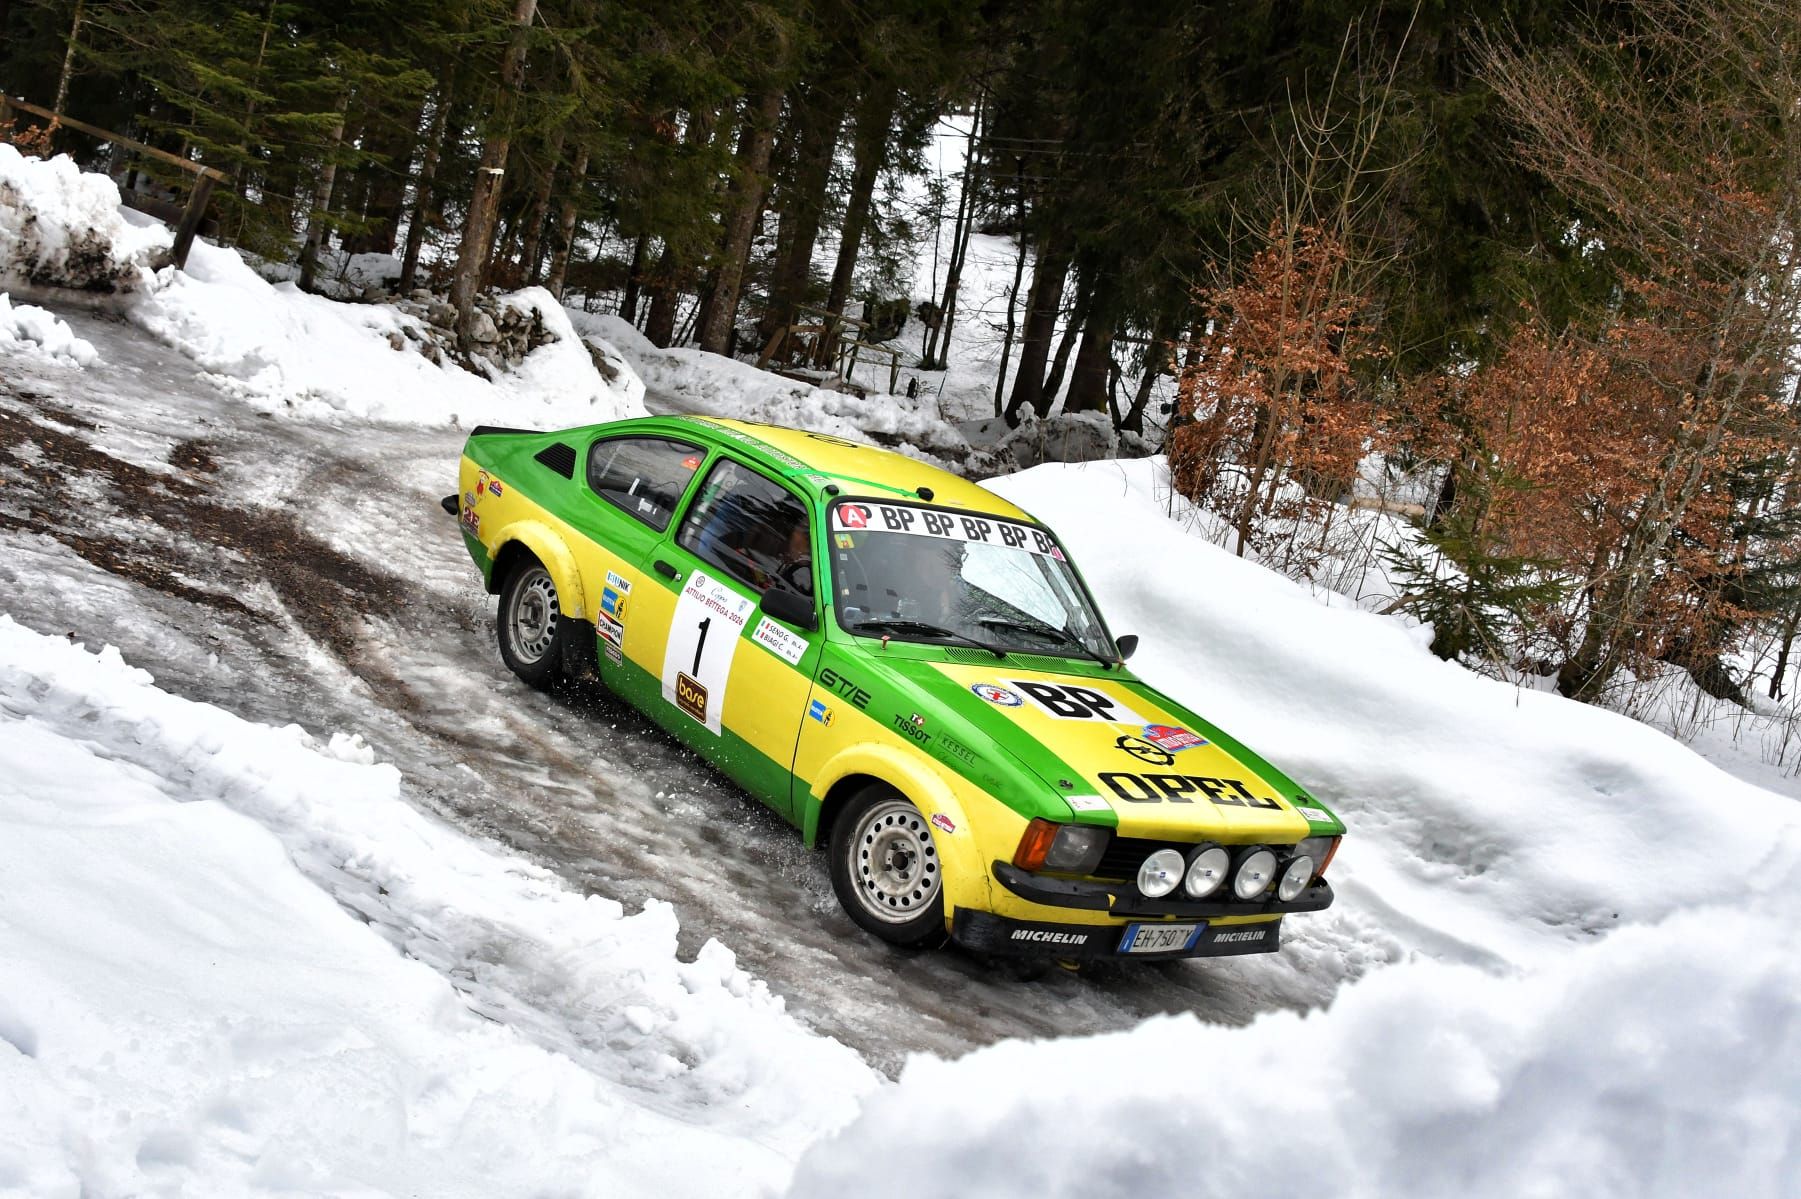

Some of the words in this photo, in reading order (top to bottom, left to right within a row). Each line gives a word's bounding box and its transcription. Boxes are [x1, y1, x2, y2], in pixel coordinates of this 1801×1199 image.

[880, 506, 914, 531] BP
[922, 512, 954, 536] BP
[960, 518, 991, 541] BP
[997, 524, 1027, 548] BP
[685, 587, 706, 602] ATTILIO
[705, 598, 729, 617] BETTEGA
[728, 612, 744, 626] 2026
[692, 617, 711, 678] 1
[763, 634, 778, 647] BIAGI
[768, 625, 785, 637] SENO
[679, 677, 705, 708] base
[820, 667, 872, 710] GT/E
[1011, 681, 1118, 721] BP
[894, 714, 931, 744] TISSOT
[941, 737, 975, 766] KESSEL
[1098, 773, 1283, 810] OPEL
[1011, 929, 1087, 945] MICHELIN
